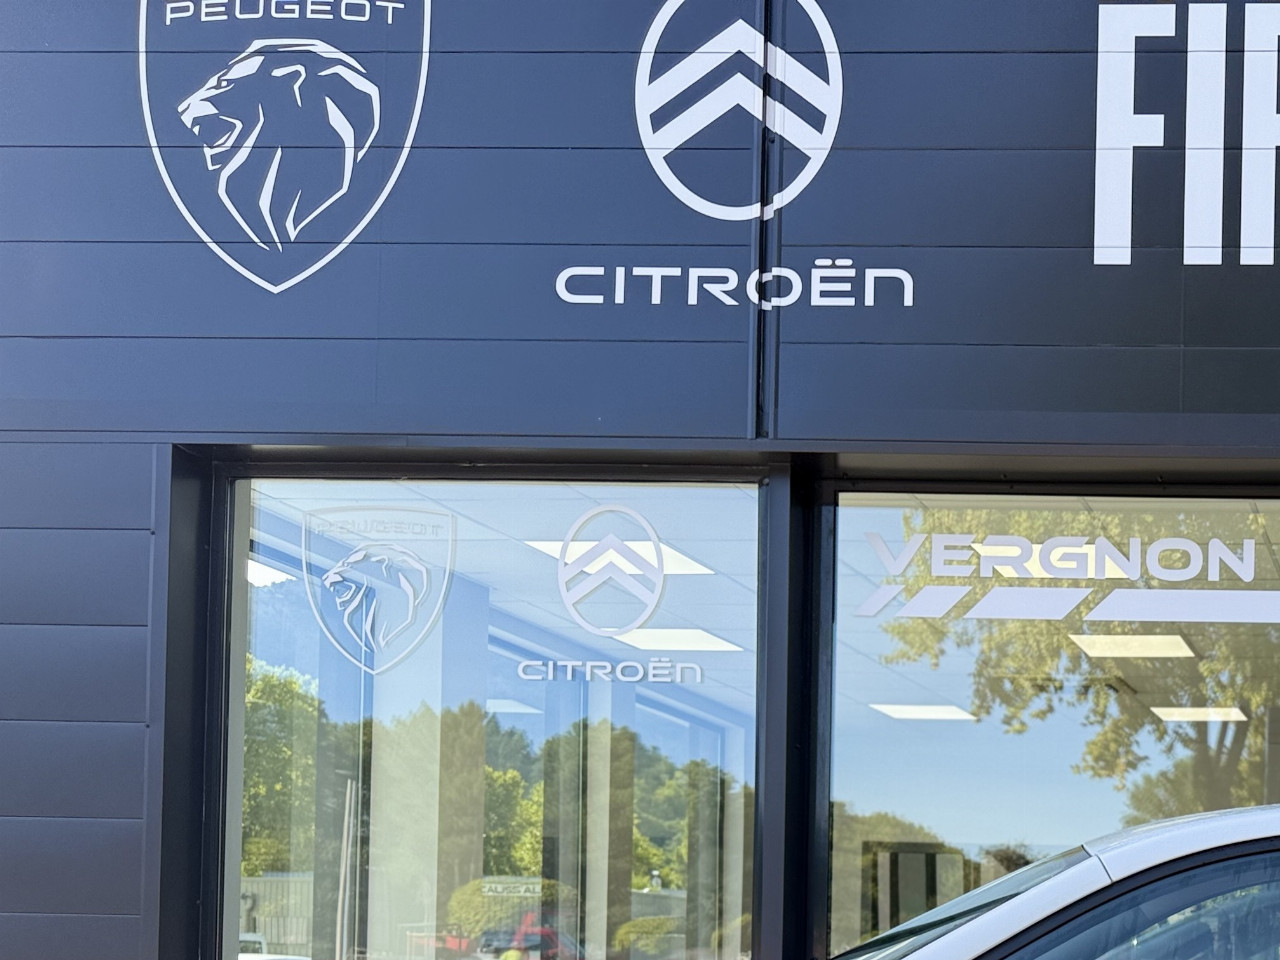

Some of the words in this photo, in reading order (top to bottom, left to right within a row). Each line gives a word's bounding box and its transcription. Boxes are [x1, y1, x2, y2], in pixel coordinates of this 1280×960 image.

[165, 0, 405, 26] PEUGEOT
[555, 258, 914, 310] CITROËN
[865, 530, 1256, 583] VERGNON
[517, 657, 703, 683] CITROËN
